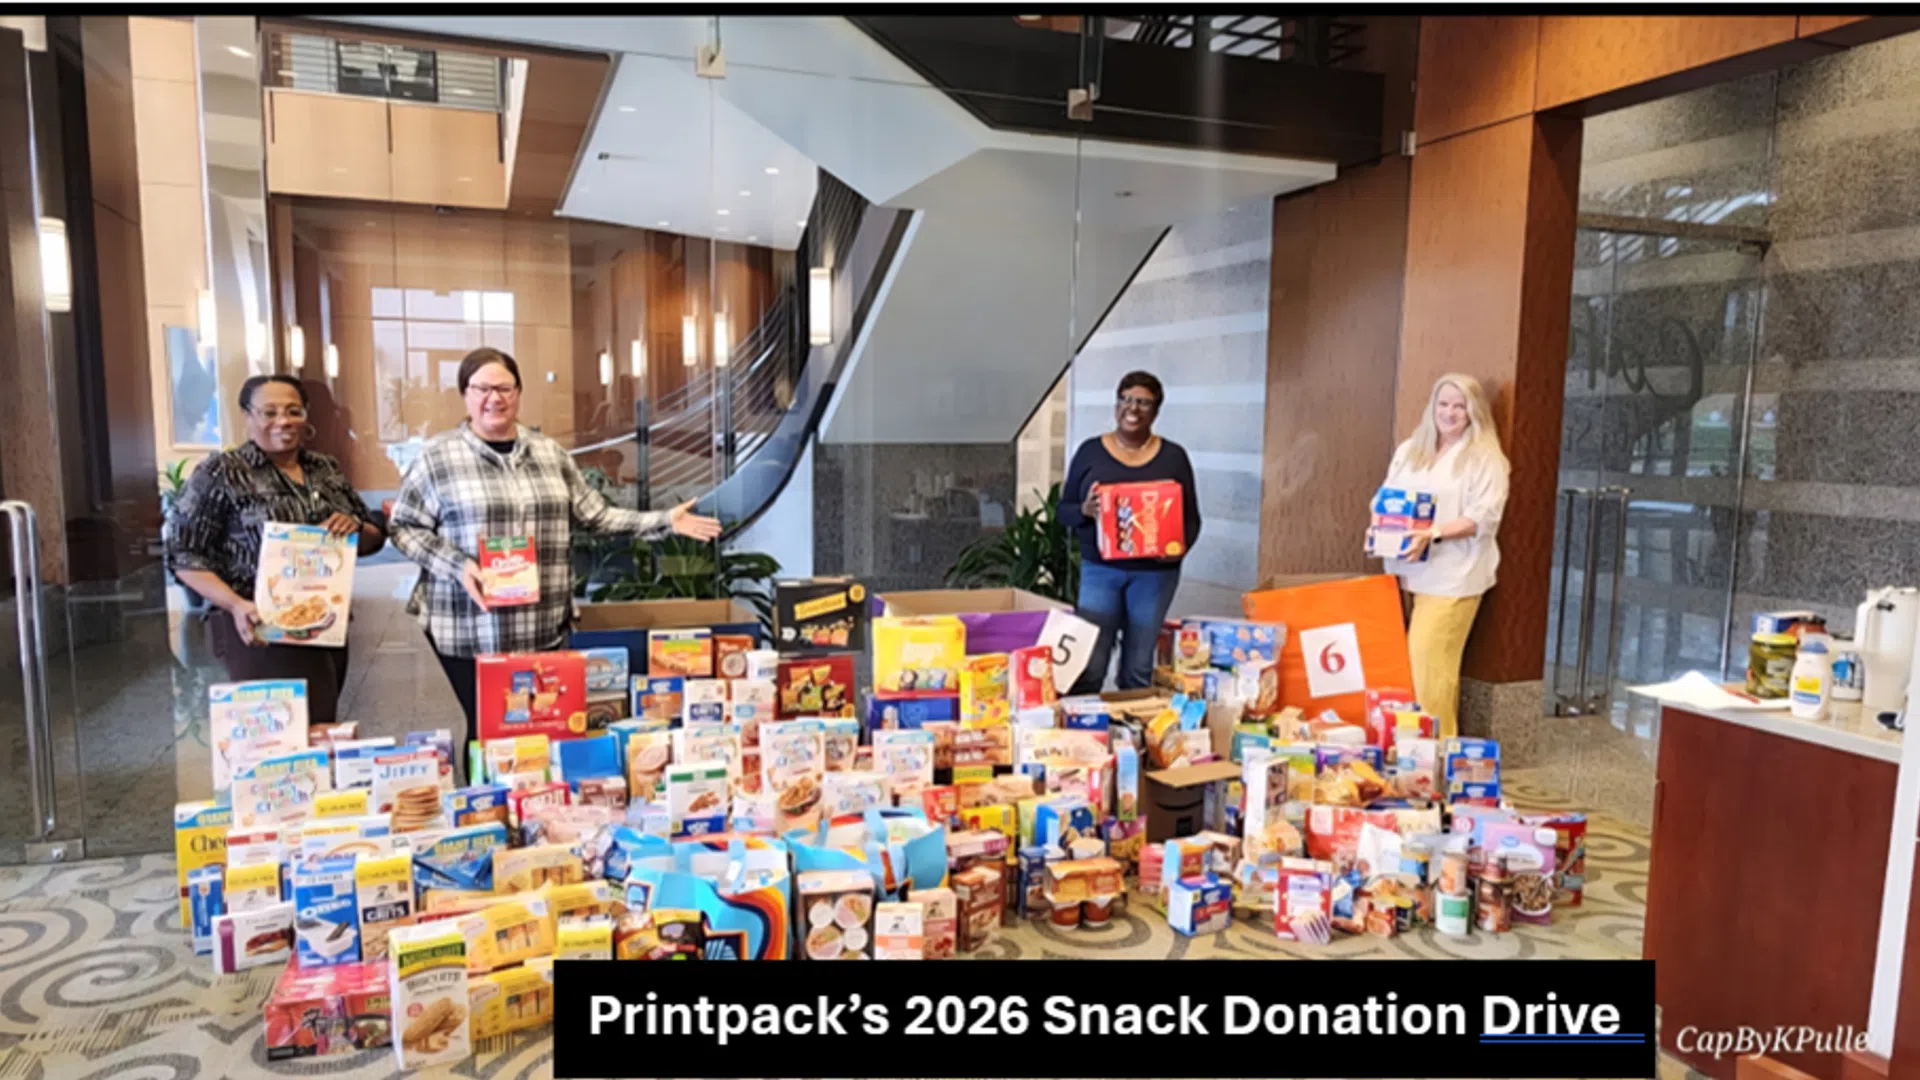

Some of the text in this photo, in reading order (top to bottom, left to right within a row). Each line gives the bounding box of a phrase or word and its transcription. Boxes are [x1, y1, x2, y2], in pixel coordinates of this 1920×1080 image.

[1051, 634, 1076, 666] 5
[1320, 641, 1346, 674] 6
[380, 763, 428, 779] JIFFY
